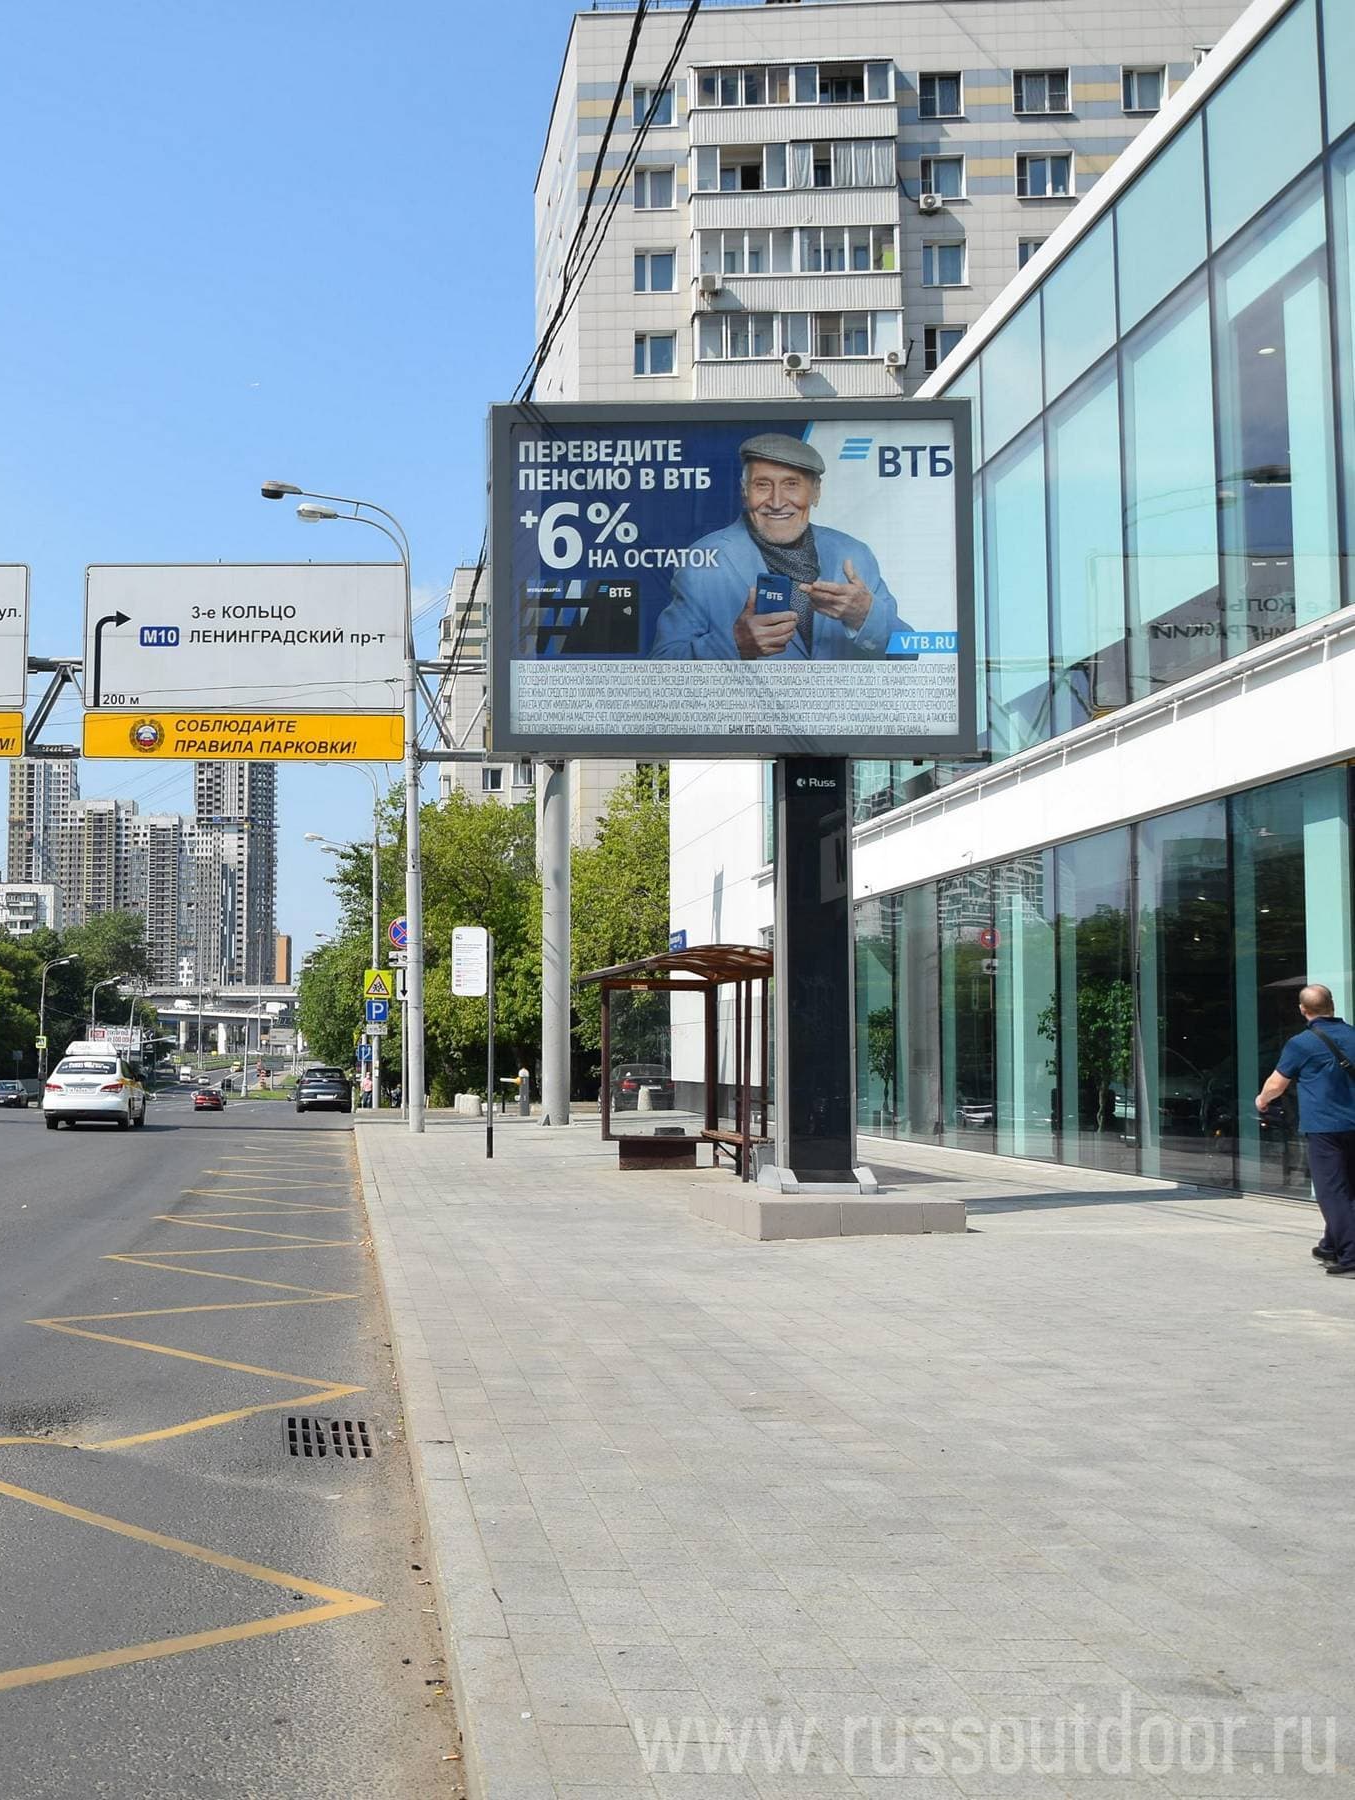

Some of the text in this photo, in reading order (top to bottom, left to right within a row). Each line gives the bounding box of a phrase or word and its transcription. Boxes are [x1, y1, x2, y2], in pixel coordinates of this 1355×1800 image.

[519, 440, 682, 466] ПЕРЕВЕДИТЕ
[879, 446, 953, 477] ВТБ
[519, 468, 711, 491] ПЕНСИЮ В ВТБ
[588, 549, 719, 568] НА ОСТАТОК
[609, 588, 632, 598] ВТБ
[766, 591, 784, 601] ВТБ
[191, 606, 297, 620] 3-е КОЛЬЦО
[189, 628, 344, 645] ЛЕНИНГРАДСКИЙ
[350, 634, 386, 647] пр-т
[900, 636, 955, 649] VTB.RU
[103, 694, 140, 705] 200 м
[175, 717, 298, 734] СОБЛЮДАЙТЕ
[174, 739, 357, 754] ПРАВИЛА ПАРКОВКИ!
[809, 778, 836, 788] Russ
